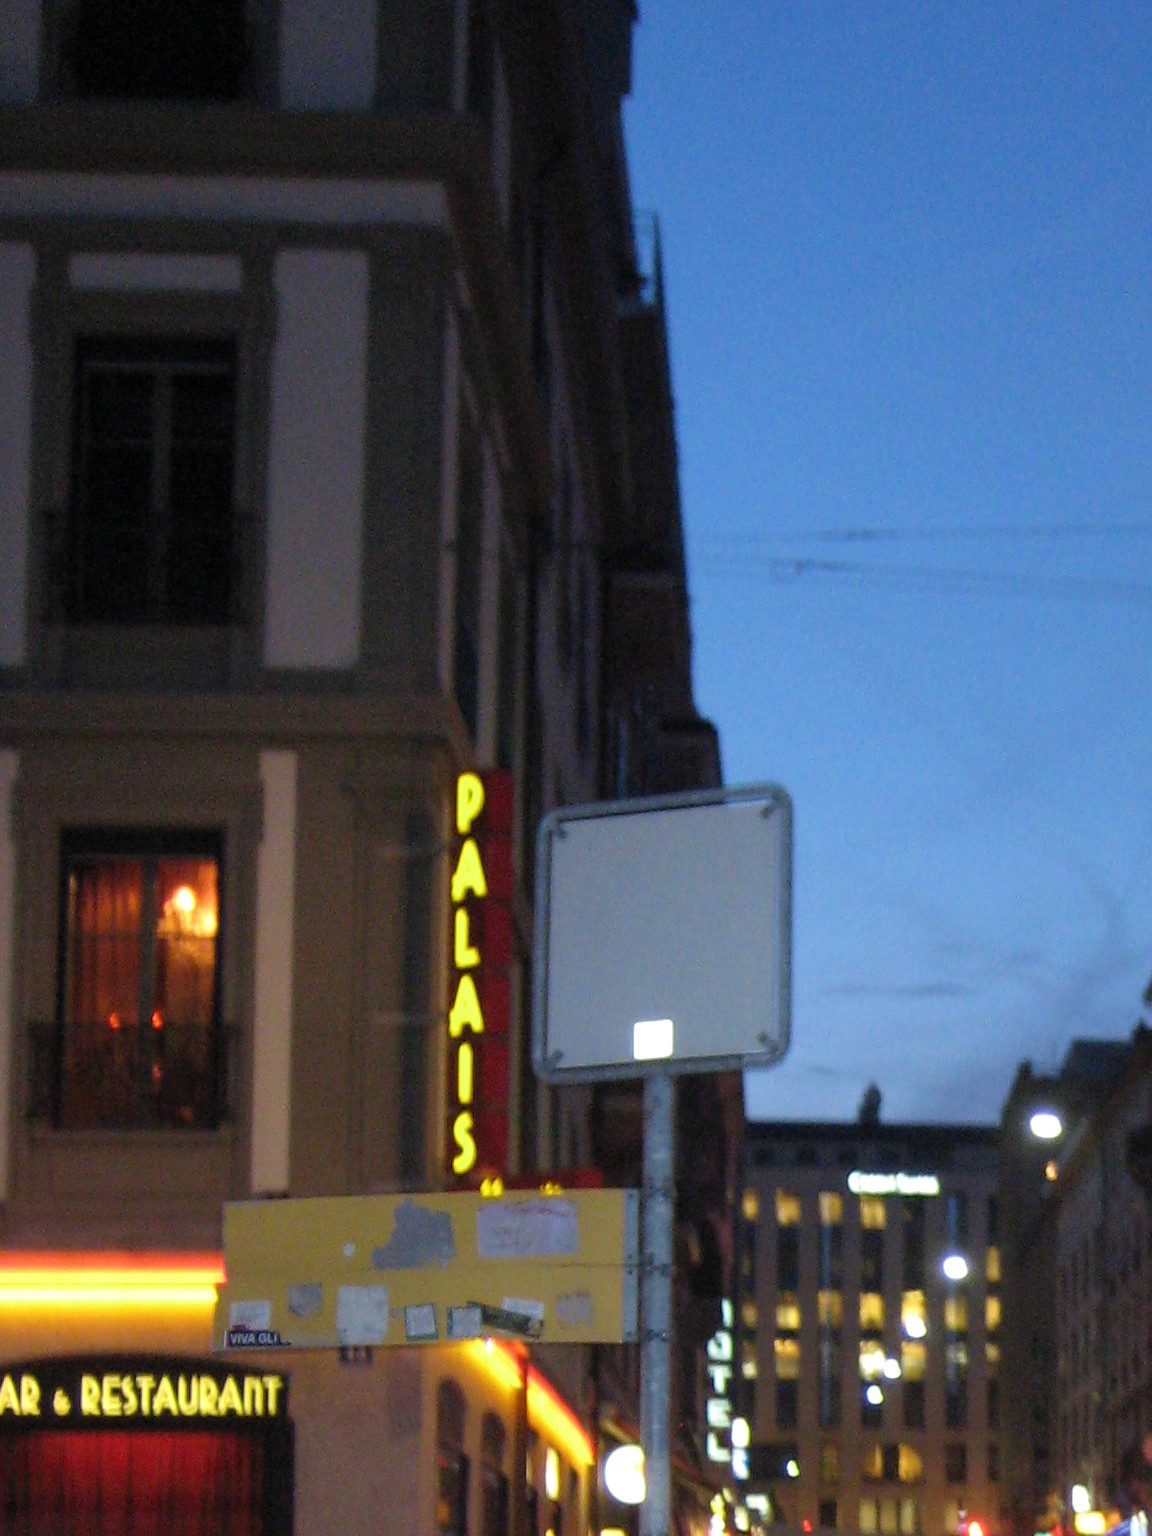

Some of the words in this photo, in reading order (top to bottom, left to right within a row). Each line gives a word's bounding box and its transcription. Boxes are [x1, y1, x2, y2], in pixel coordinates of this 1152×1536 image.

[449, 773, 487, 1174] PALAIS
[230, 1333, 255, 1344] VIVA
[0, 1372, 41, 1417] AR
[80, 1372, 283, 1419] RESTAURANT
